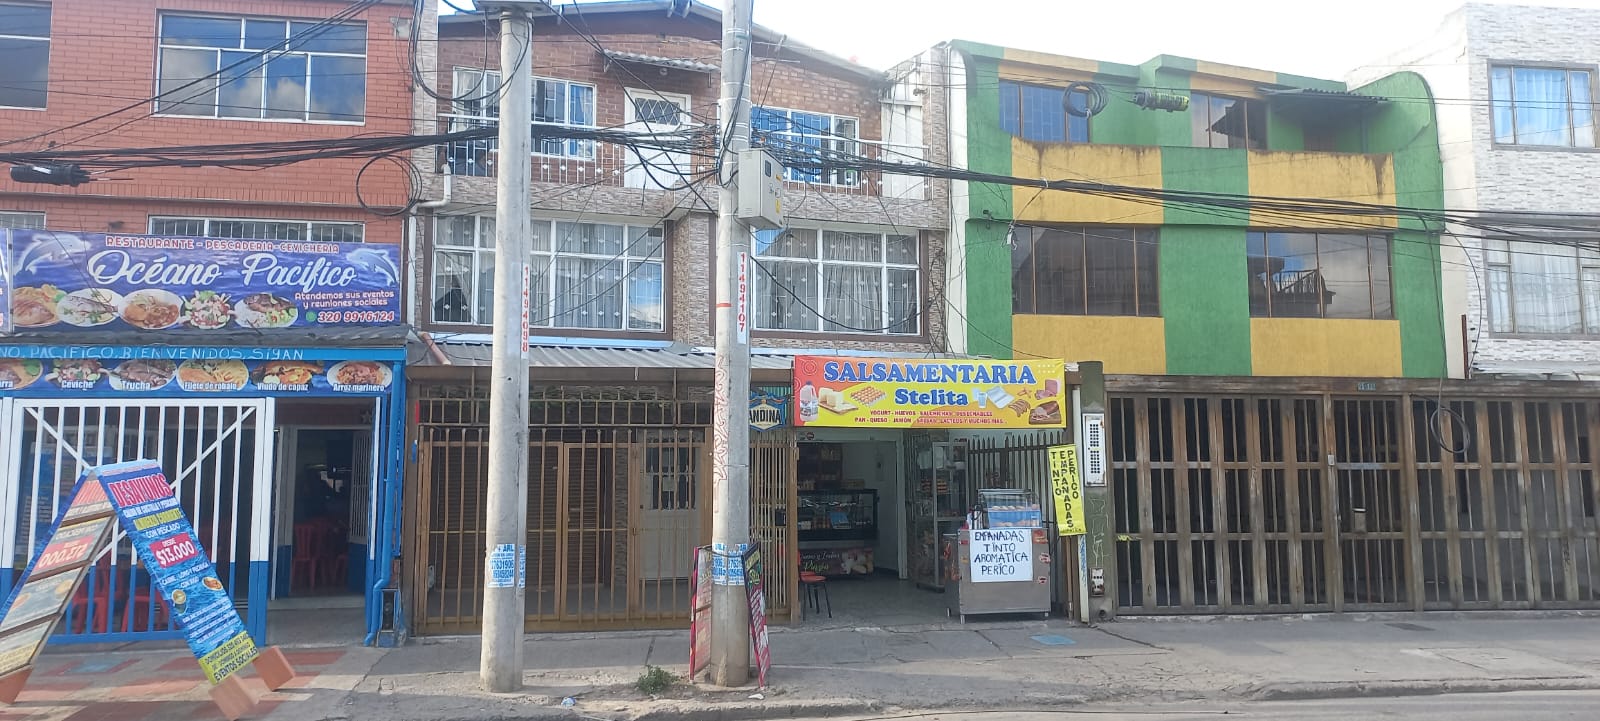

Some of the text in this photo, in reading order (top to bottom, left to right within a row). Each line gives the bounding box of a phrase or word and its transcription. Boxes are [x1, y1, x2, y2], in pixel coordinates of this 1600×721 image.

[106, 236, 194, 249] RESTAURANTE
[87, 249, 357, 293] Océano Pacifico
[294, 290, 394, 300] Atendemos sus eventos
[303, 298, 388, 310] y reuniones sociales
[317, 311, 395, 323] 320 9916124
[824, 361, 1036, 385] SALSAMENTARIA
[122, 380, 151, 390] Trucha
[257, 382, 277, 391] Viudo
[278, 383, 287, 391] de
[333, 384, 384, 392] Arroz marinero
[894, 388, 969, 406] Stelita
[1051, 451, 1062, 496] TINTO
[1067, 449, 1079, 500] PERICO
[107, 473, 174, 508] DESAYUNOS
[1059, 450, 1074, 528] EMPANADAS
[158, 522, 181, 537] PESCADO
[974, 530, 1025, 543] EMPANADAS
[155, 540, 195, 566] $13.000
[974, 551, 1029, 564] AROMATICA
[981, 563, 1015, 576] PERICO
[213, 646, 259, 682] EVENTOS SOCIALES
